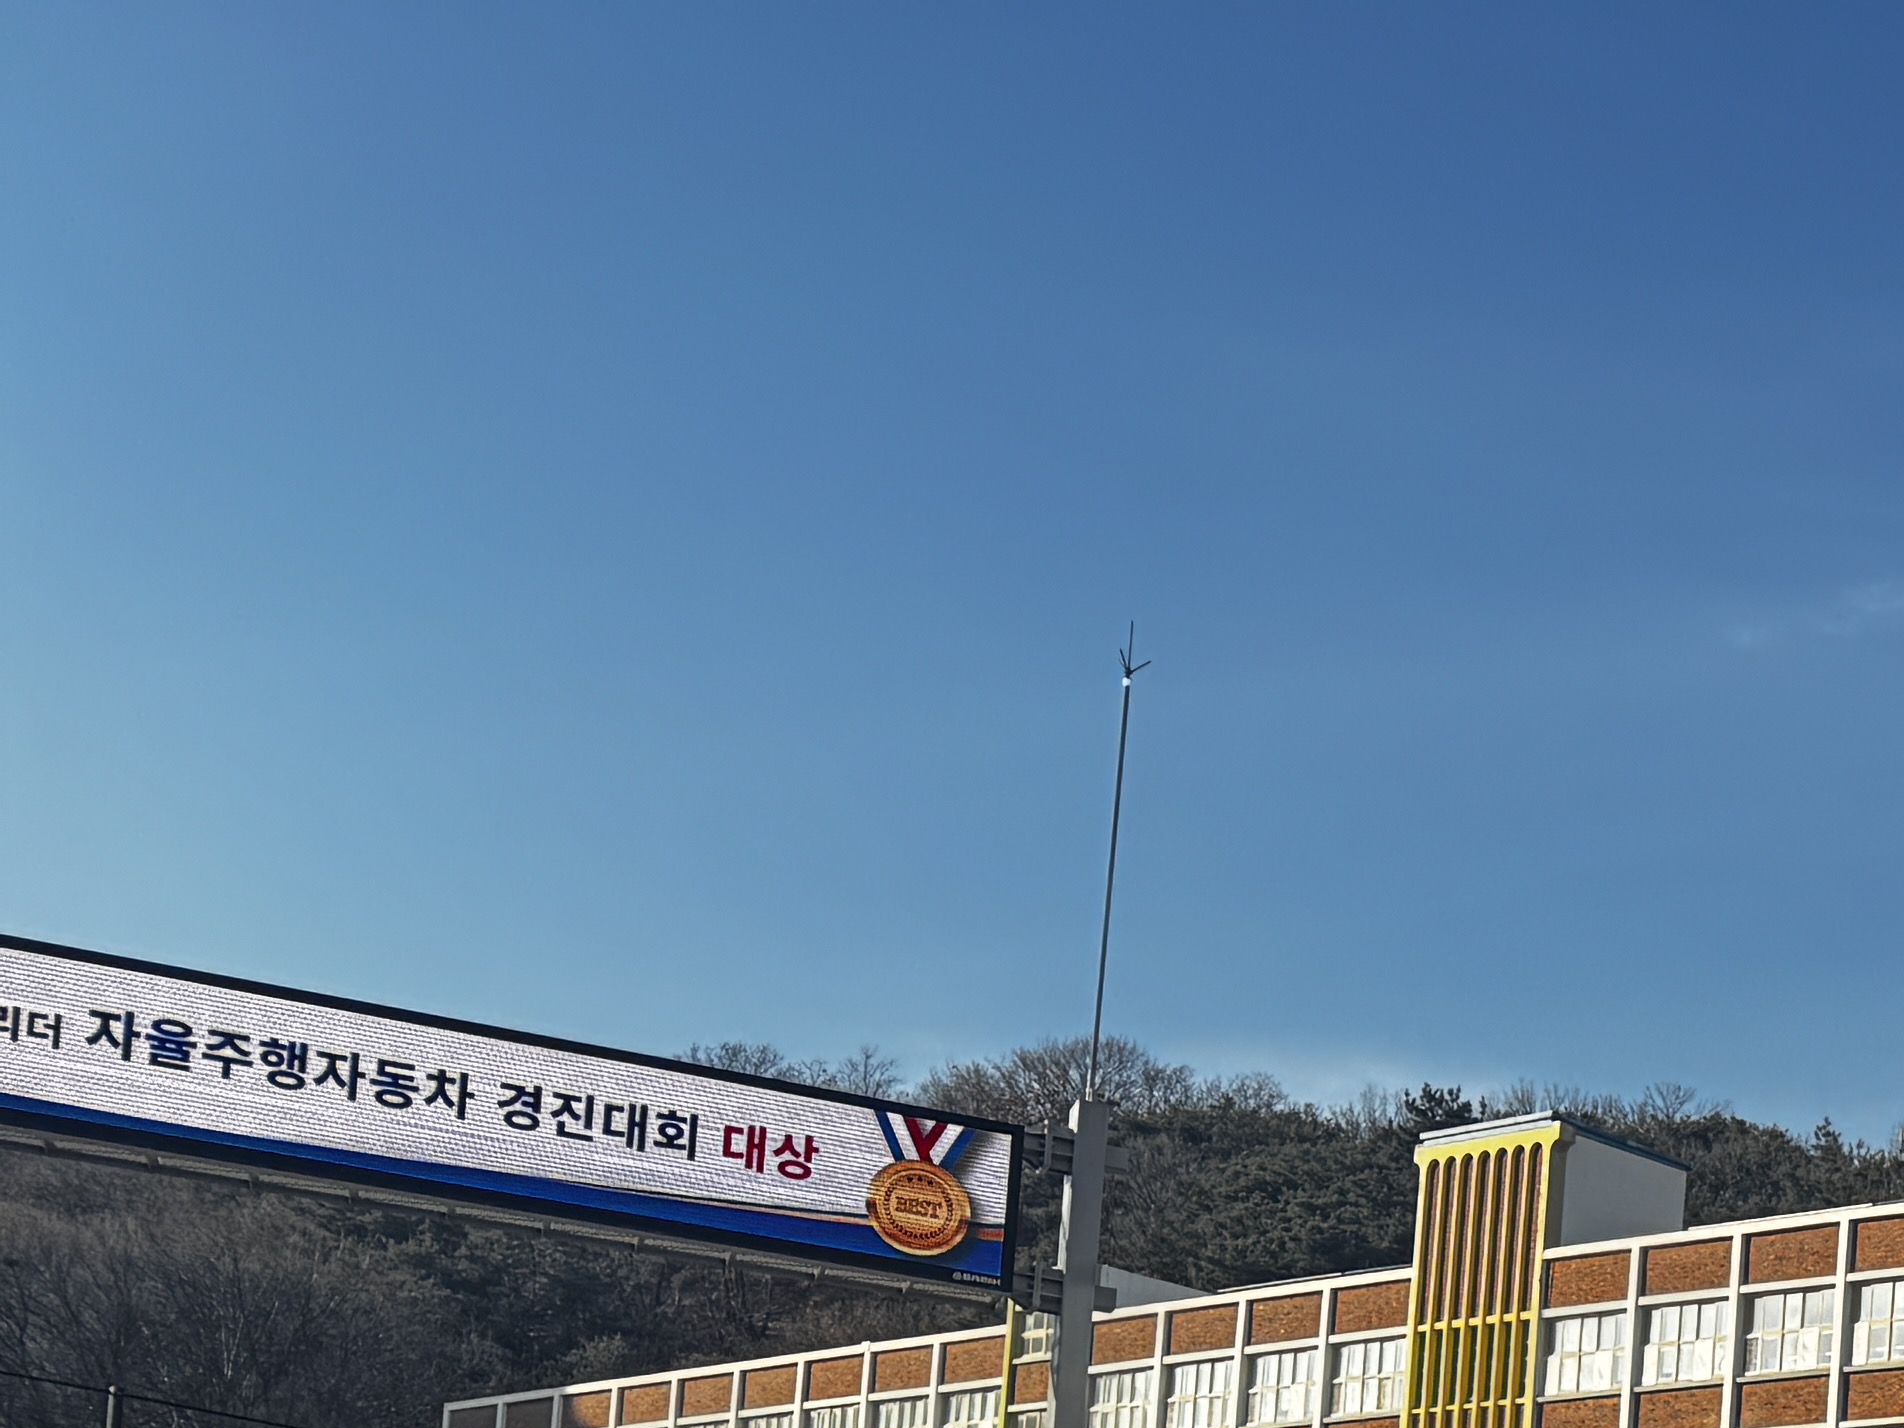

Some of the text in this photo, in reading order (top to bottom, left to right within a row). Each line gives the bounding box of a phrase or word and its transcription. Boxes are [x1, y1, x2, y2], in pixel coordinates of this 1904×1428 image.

[86, 1009, 475, 1120] 자율주행자동차
[497, 1081, 699, 1160] 경진대회
[722, 1123, 820, 1181] 대상
